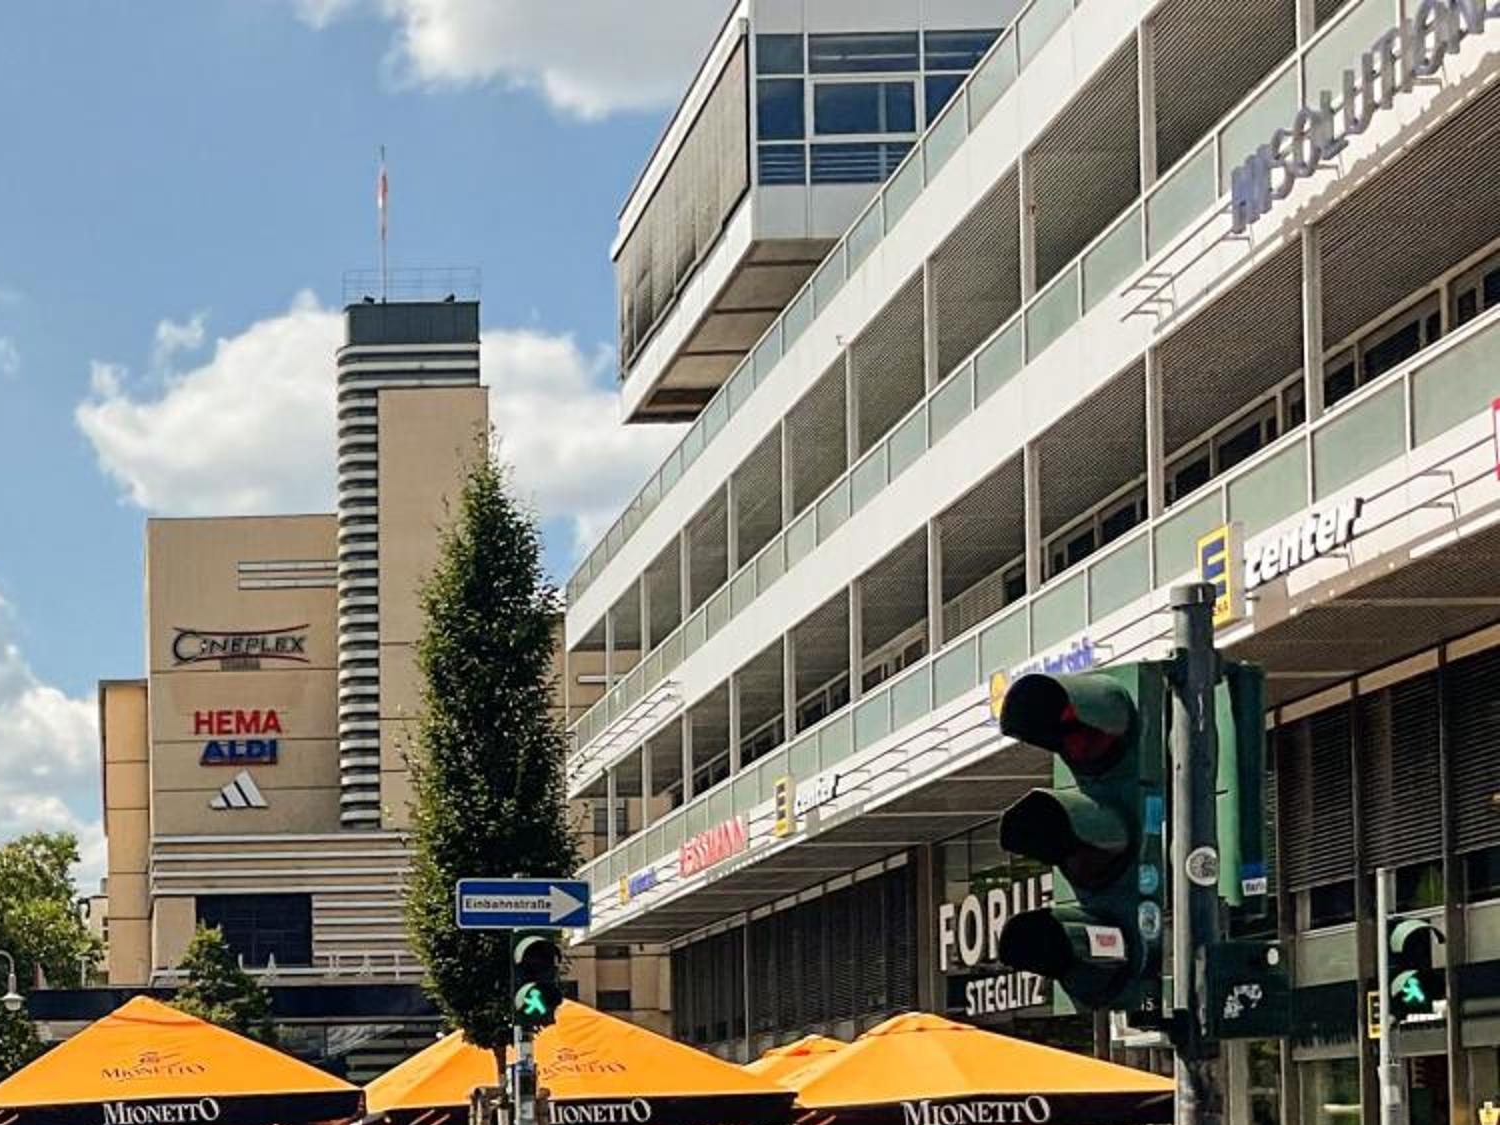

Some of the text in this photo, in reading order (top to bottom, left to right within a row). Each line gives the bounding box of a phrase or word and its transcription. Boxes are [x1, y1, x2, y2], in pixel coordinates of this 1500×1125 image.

[1231, 0, 1500, 233] HISOLUTION
[194, 709, 282, 735] HEMA
[201, 739, 278, 764] ALDI
[465, 898, 552, 910] Einbahnstraße
[965, 971, 1045, 1016] STEGLITZ
[537, 1062, 627, 1076] IONETTO
[103, 1097, 220, 1125] MIONETTO
